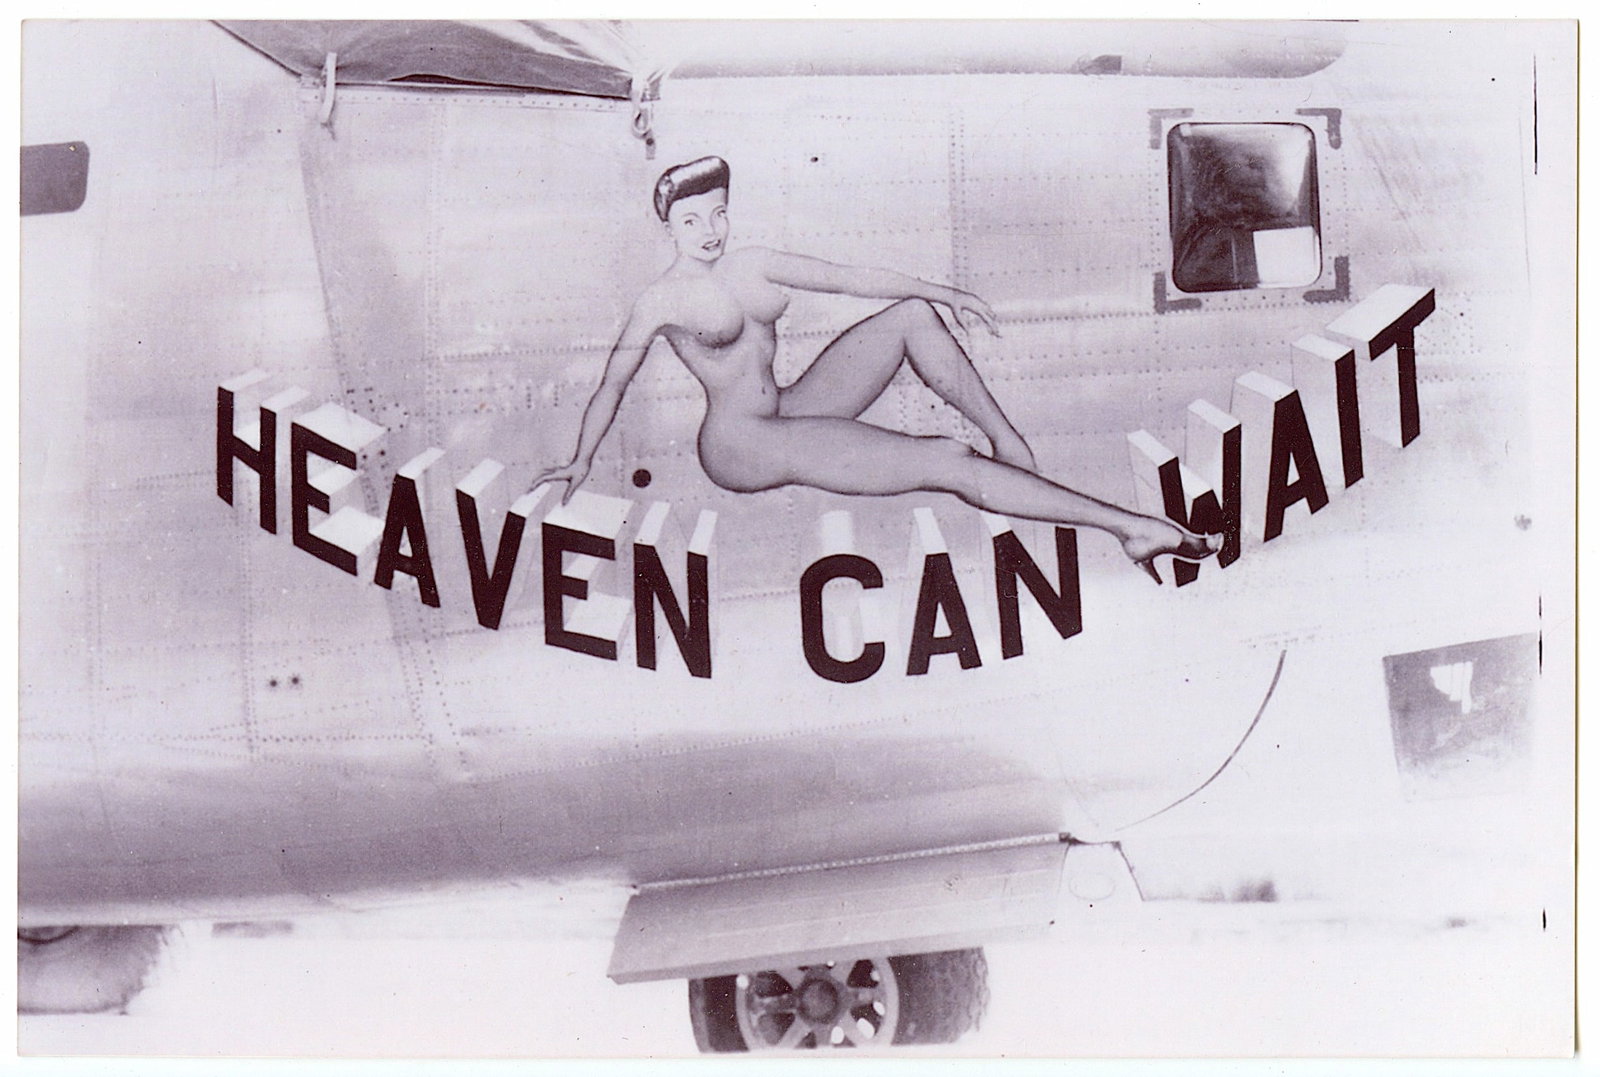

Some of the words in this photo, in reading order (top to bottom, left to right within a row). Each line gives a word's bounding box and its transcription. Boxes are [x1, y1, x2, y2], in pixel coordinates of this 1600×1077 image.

[216, 385, 712, 679] HEAVEN
[800, 525, 1083, 684] CAN
[1158, 287, 1437, 588] WAIT
